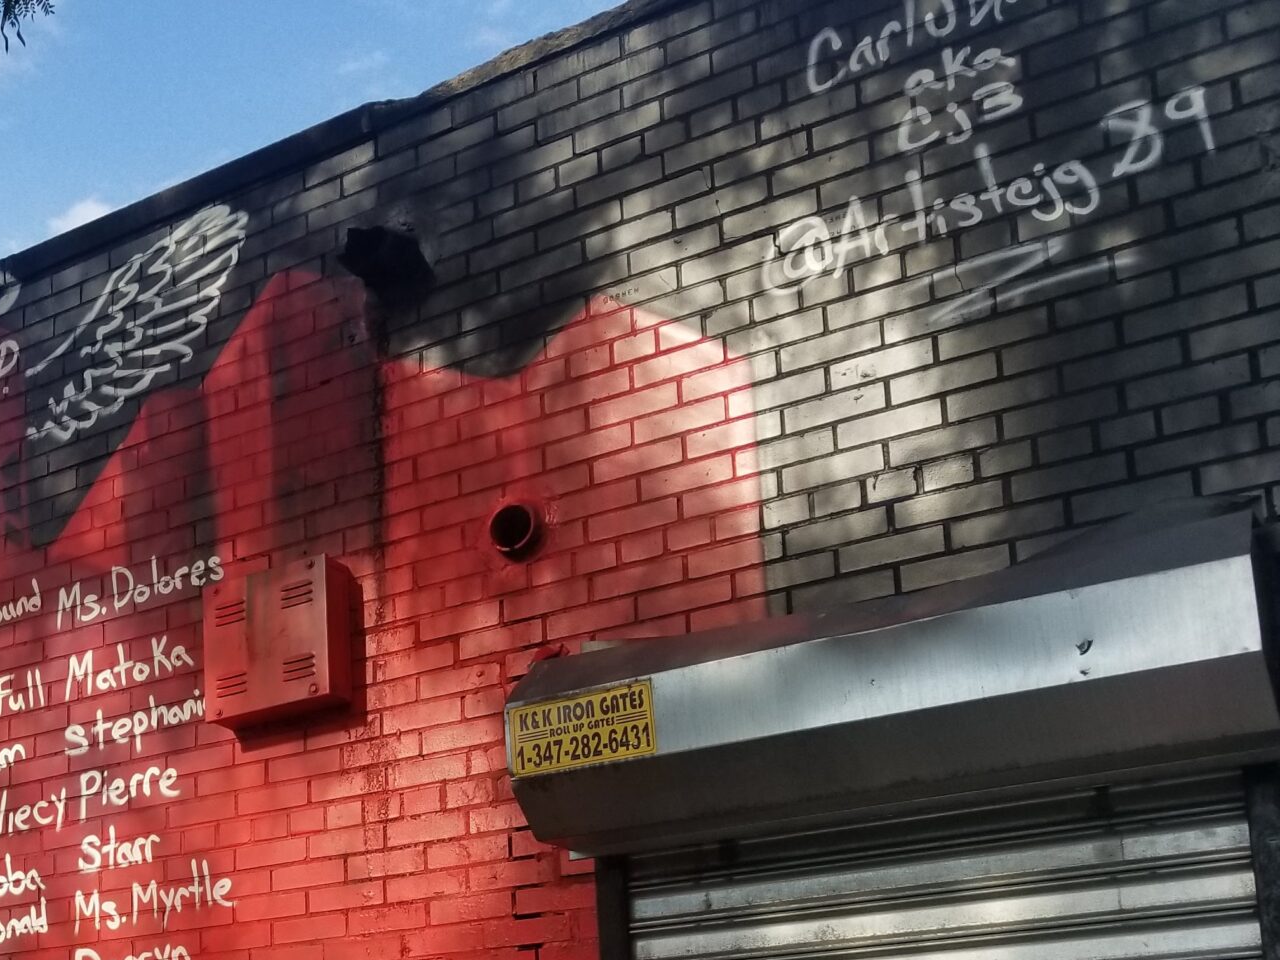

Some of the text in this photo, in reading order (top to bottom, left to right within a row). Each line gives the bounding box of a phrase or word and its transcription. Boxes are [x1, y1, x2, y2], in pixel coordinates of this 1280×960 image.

[111, 555, 224, 612] Dolores
[64, 688, 206, 756] Stephani
[549, 717, 616, 738] ROLL UP GATES
[557, 699, 595, 724] IRON
[599, 688, 645, 716] GATES
[516, 722, 651, 770] 1-347-282-6431
[80, 766, 181, 820] Pierre
[78, 824, 160, 873] Starr
[131, 857, 235, 931] Myrtle
